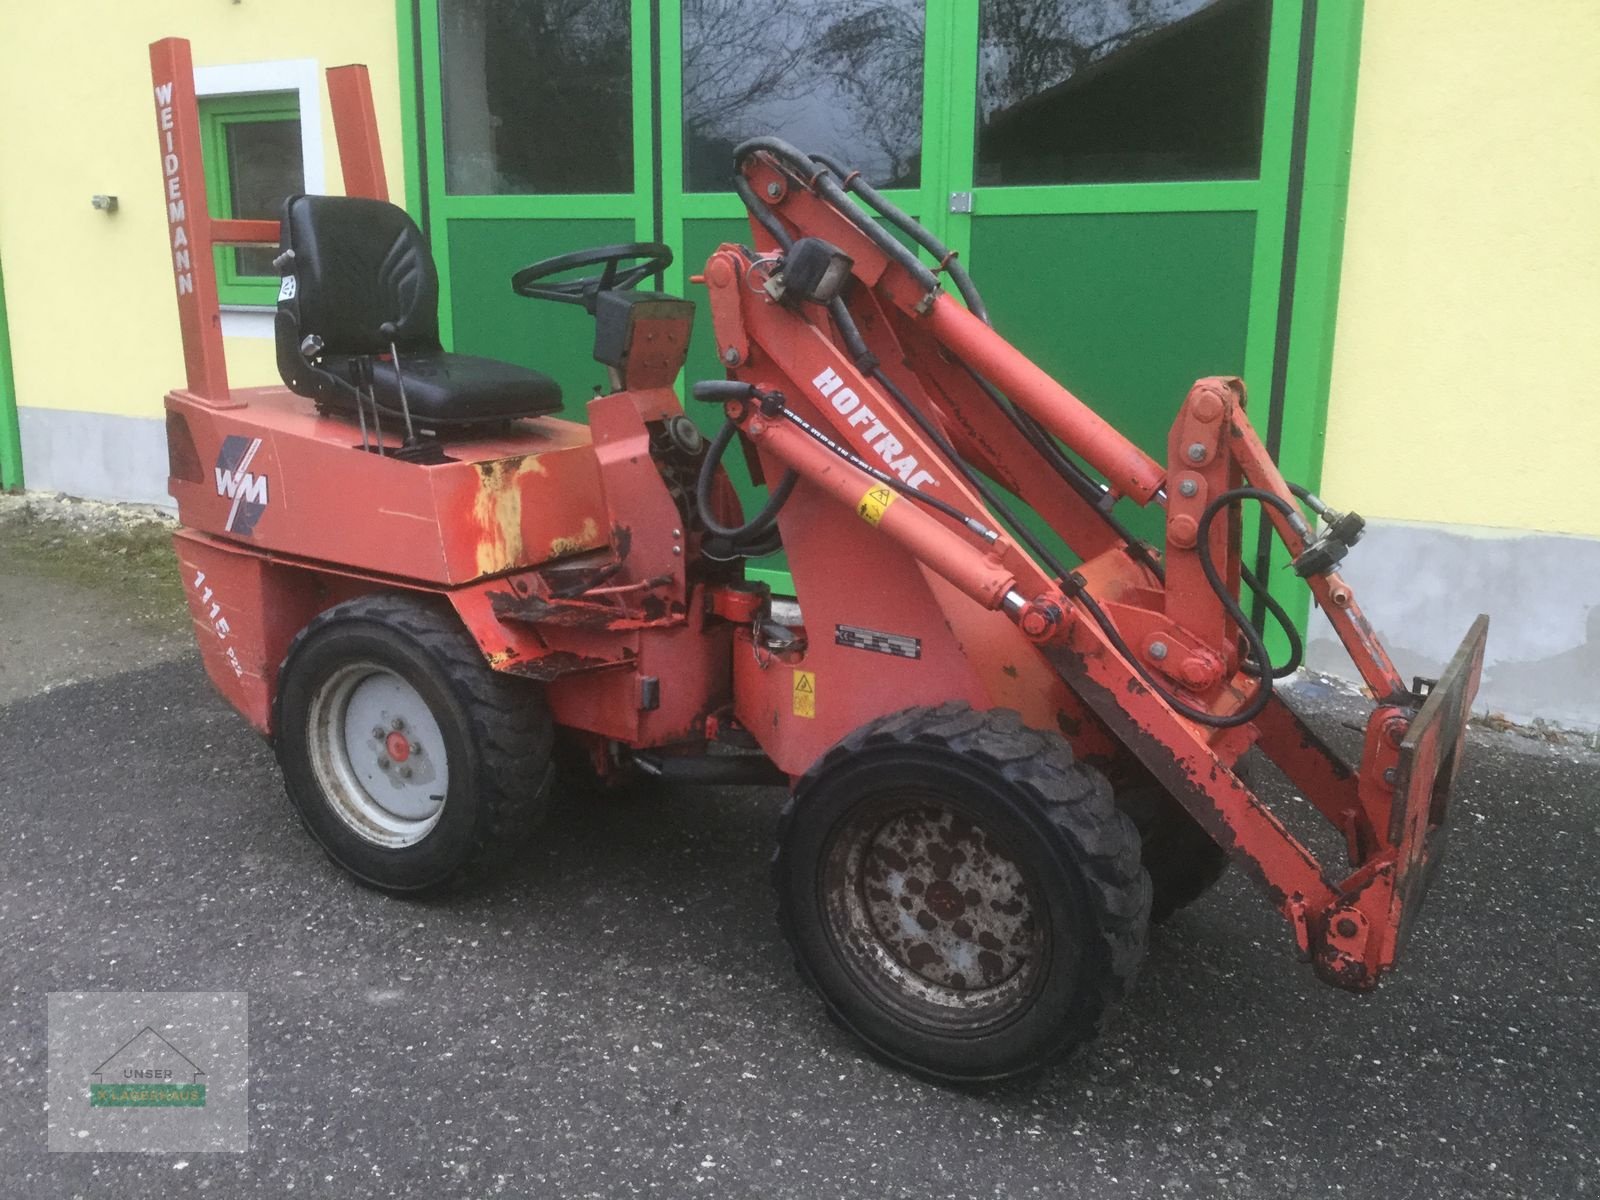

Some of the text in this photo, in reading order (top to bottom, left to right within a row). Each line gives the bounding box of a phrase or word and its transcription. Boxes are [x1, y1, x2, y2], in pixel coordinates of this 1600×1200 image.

[155, 82, 192, 295] WEIDEMANN
[812, 366, 936, 490] HOFTRAC
[214, 467, 268, 505] WM
[194, 570, 230, 640] 1115
